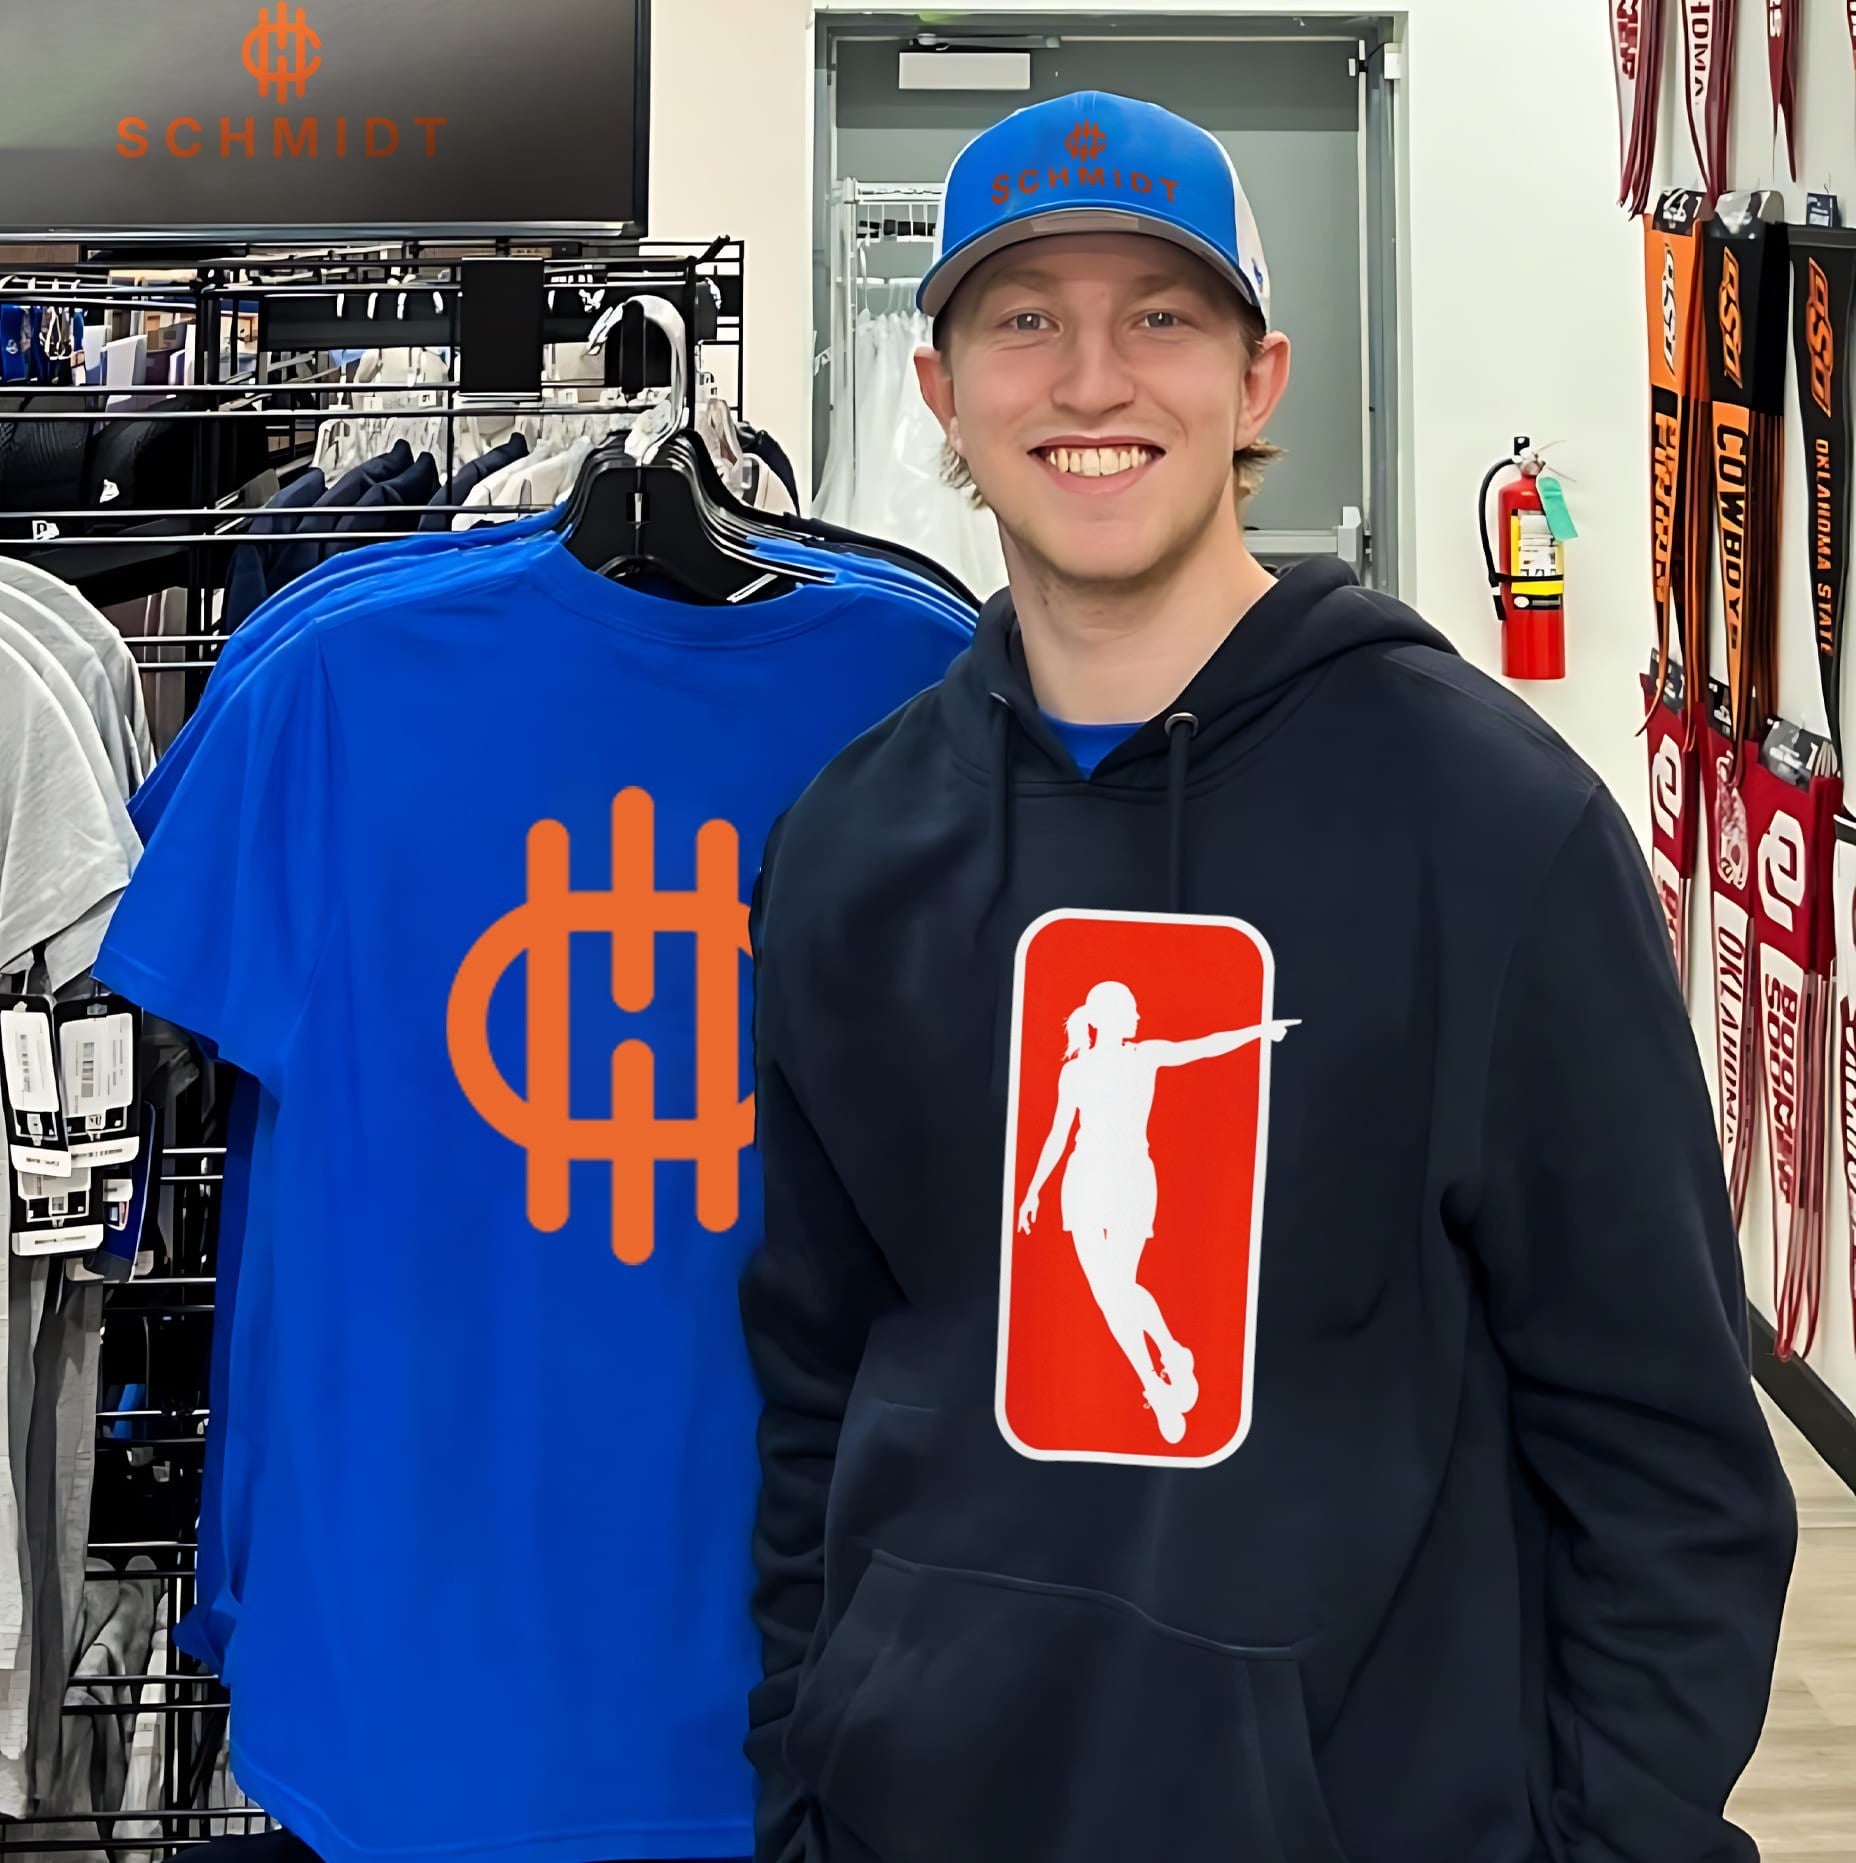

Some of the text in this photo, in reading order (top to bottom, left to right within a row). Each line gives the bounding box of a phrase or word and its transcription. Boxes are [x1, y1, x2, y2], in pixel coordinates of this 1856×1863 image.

[115, 116, 448, 160] SCHMIDT
[991, 166, 1180, 205] SCHMIDT
[1815, 438, 1832, 571] OKLAHOMA
[1718, 925, 1745, 1144] OKLAHOMA
